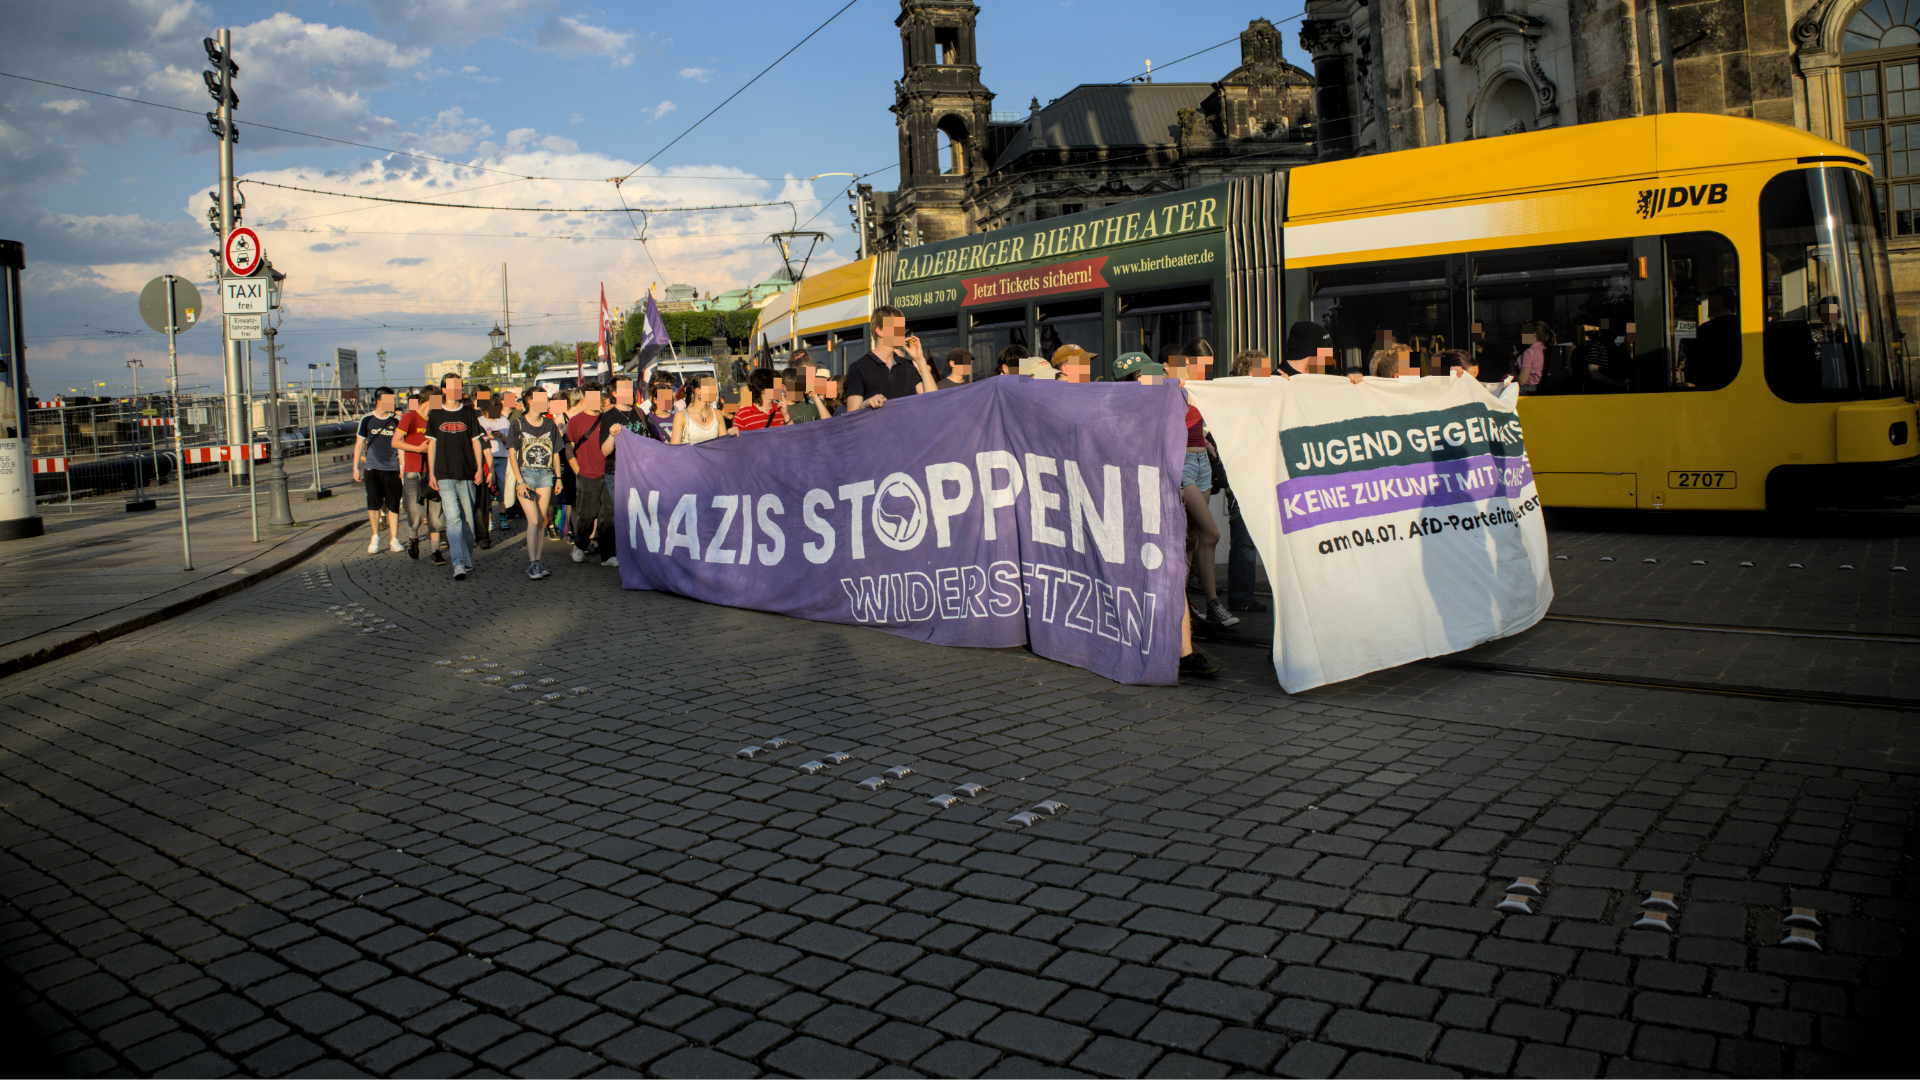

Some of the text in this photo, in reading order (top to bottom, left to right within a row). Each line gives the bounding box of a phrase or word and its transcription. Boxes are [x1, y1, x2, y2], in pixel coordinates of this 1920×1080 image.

[1667, 183, 1728, 208] DVB
[896, 198, 1217, 282] RADEBERGER BIERTHEATER
[1112, 248, 1215, 276] www.biertheater.de
[228, 284, 262, 298] TAXI
[894, 288, 957, 308] (03528) 48 70 70
[973, 265, 1092, 300] Jetzt Tickets sichern!
[1296, 429, 1402, 471] JUGEND
[1284, 486, 1350, 519] KEINE
[1351, 473, 1452, 504] ZUKUNFT
[1457, 465, 1495, 491] MIT
[1679, 473, 1724, 487] 2707
[628, 450, 1164, 570] NAZIS STOPPEN!
[1318, 533, 1350, 555] am
[1352, 524, 1404, 548] 04.07.
[840, 560, 1157, 655] WIDERSETZEN
